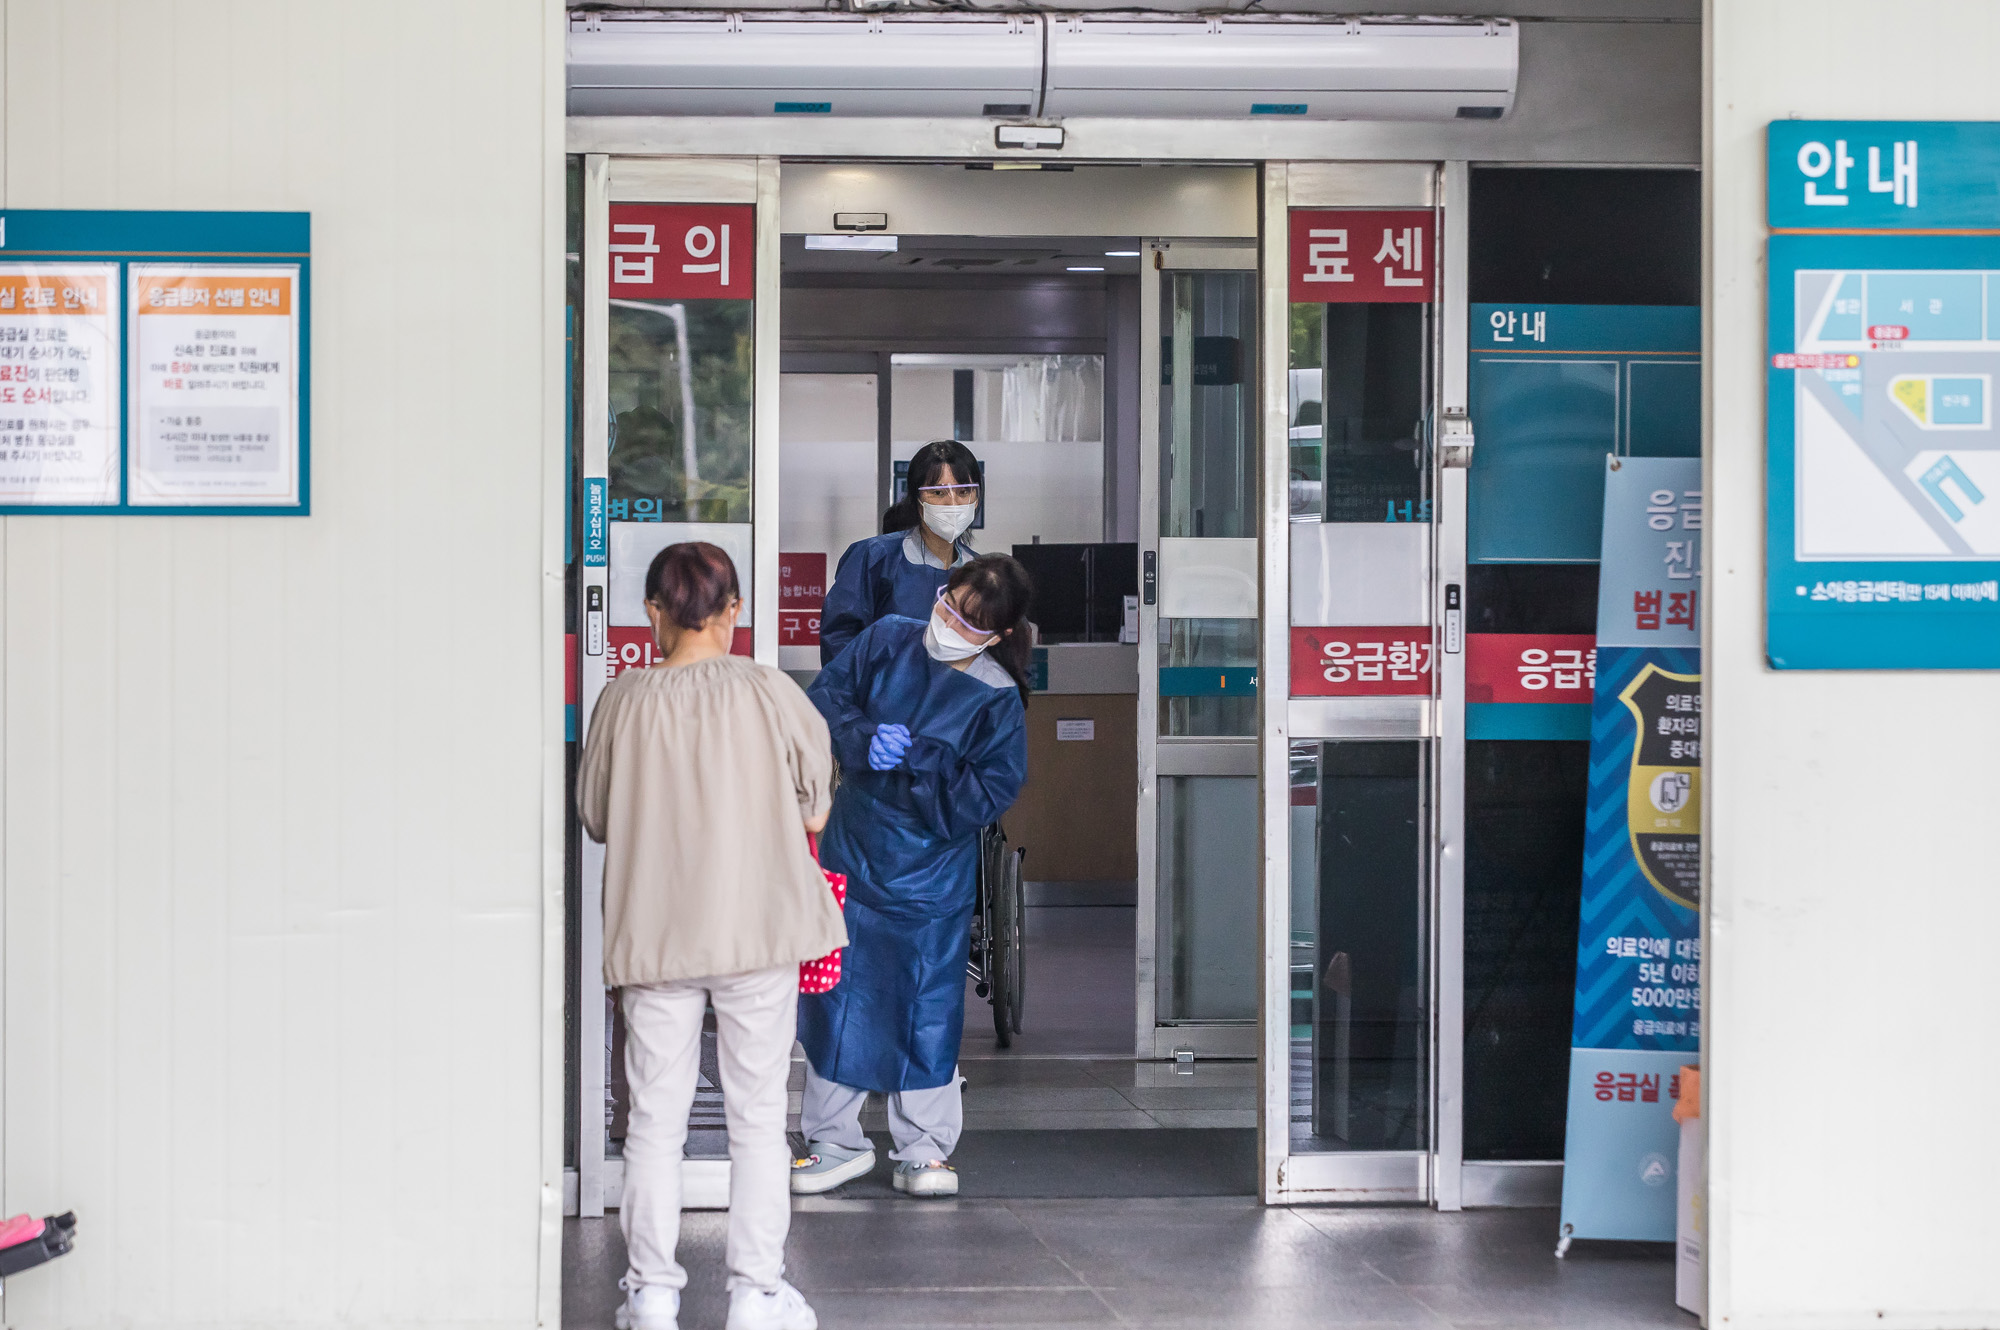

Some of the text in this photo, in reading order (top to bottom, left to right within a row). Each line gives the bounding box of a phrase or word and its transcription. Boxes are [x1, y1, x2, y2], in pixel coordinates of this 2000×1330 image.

[1797, 139, 1918, 208] 안내
[22, 287, 57, 308] 진료
[62, 287, 98, 308] 안내
[150, 287, 280, 307] 응급환자 선별 안내
[1490, 311, 1546, 343] 안내
[590, 483, 602, 549] 눌러주십시오
[585, 554, 605, 562] PUSH
[1664, 540, 1703, 580] 진
[779, 585, 824, 597] 능합니다.
[1634, 589, 1696, 631] 범죄
[1657, 716, 1700, 735] 환자의
[1670, 740, 1702, 758] 중대
[1606, 936, 1670, 958] 의료인에
[1639, 963, 1665, 984] 5년
[1594, 1071, 1660, 1102] 응급실
